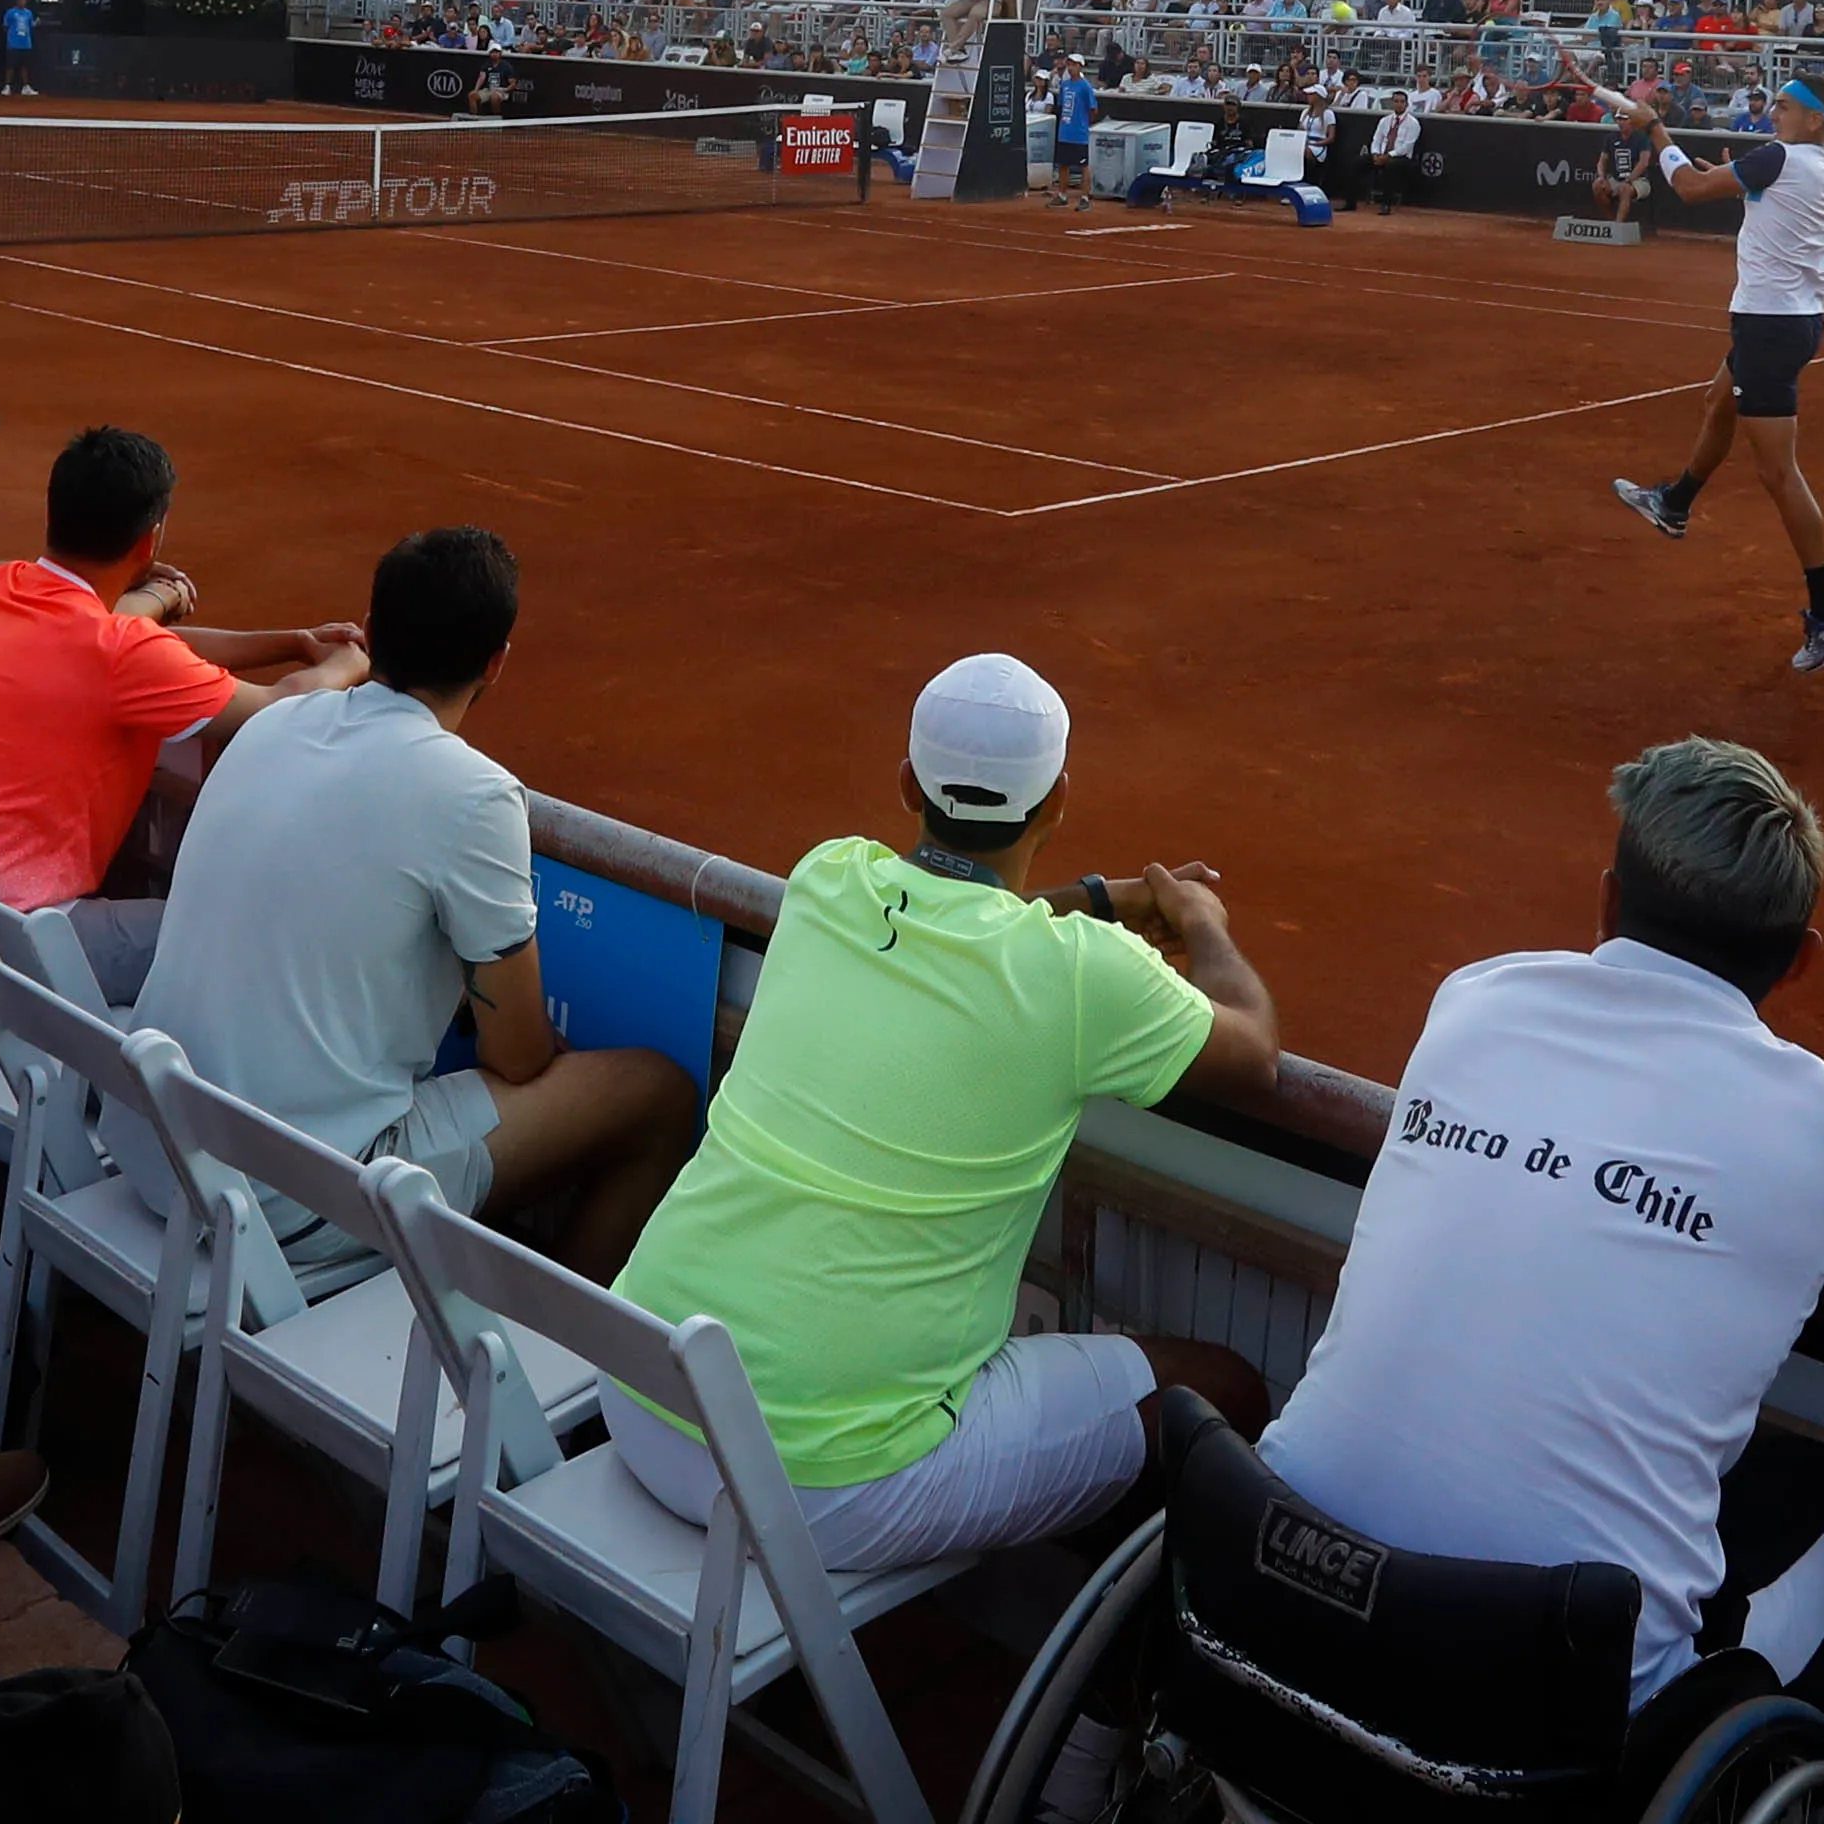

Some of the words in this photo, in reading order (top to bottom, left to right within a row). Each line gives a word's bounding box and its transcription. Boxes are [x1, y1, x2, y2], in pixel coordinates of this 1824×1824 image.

[433, 76, 456, 92] KIA
[786, 126, 851, 146] Emirates
[795, 148, 811, 164] FLY
[811, 147, 841, 164] BETTER
[266, 180, 373, 224] ATP
[382, 176, 496, 217] TOUR
[554, 890, 594, 915] ATP
[1398, 1098, 1509, 1160] Banco
[1524, 1138, 1572, 1180] de
[1594, 1159, 1714, 1242] Chile
[1268, 1516, 1375, 1587] LINCE
